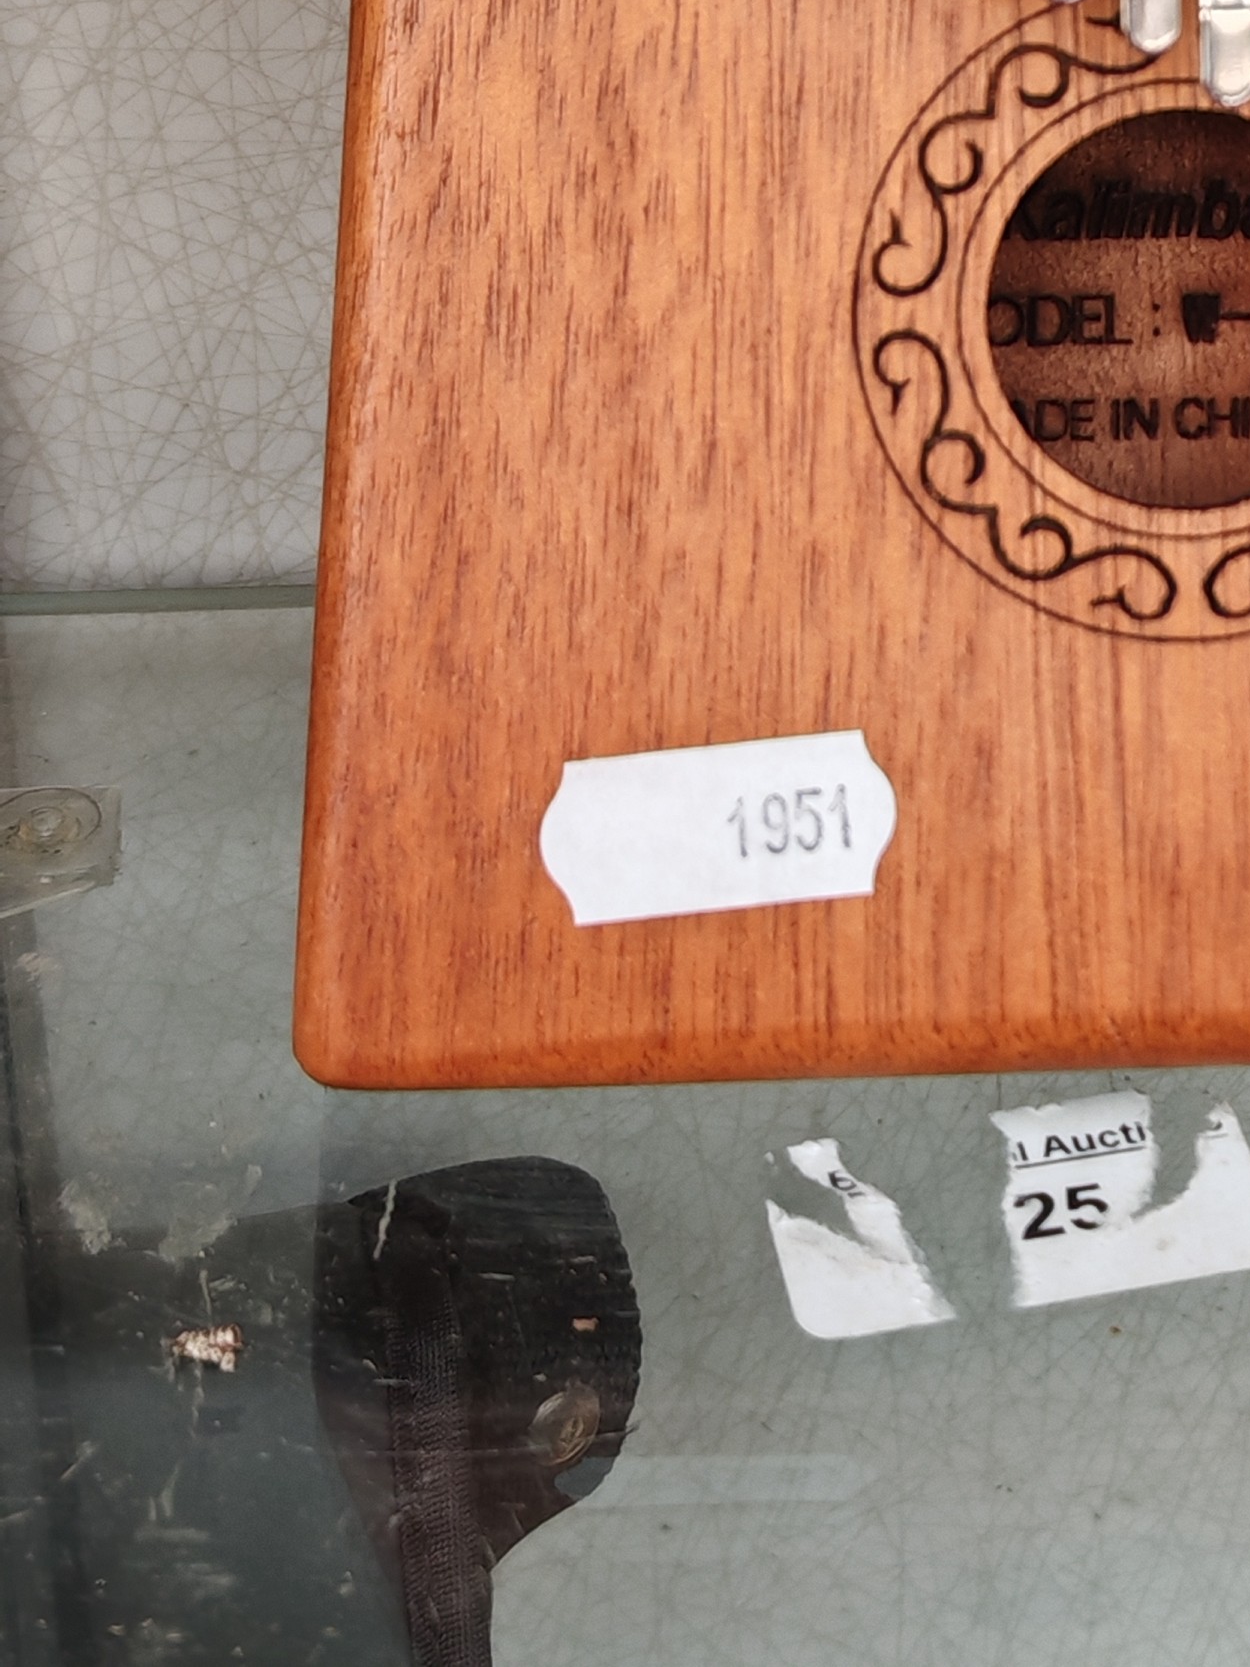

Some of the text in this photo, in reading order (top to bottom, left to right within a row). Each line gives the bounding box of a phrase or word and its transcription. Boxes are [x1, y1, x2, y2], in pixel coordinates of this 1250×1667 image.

[1111, 396, 1161, 442] IN
[727, 782, 853, 859] 1951
[1013, 1182, 1110, 1241] 25
